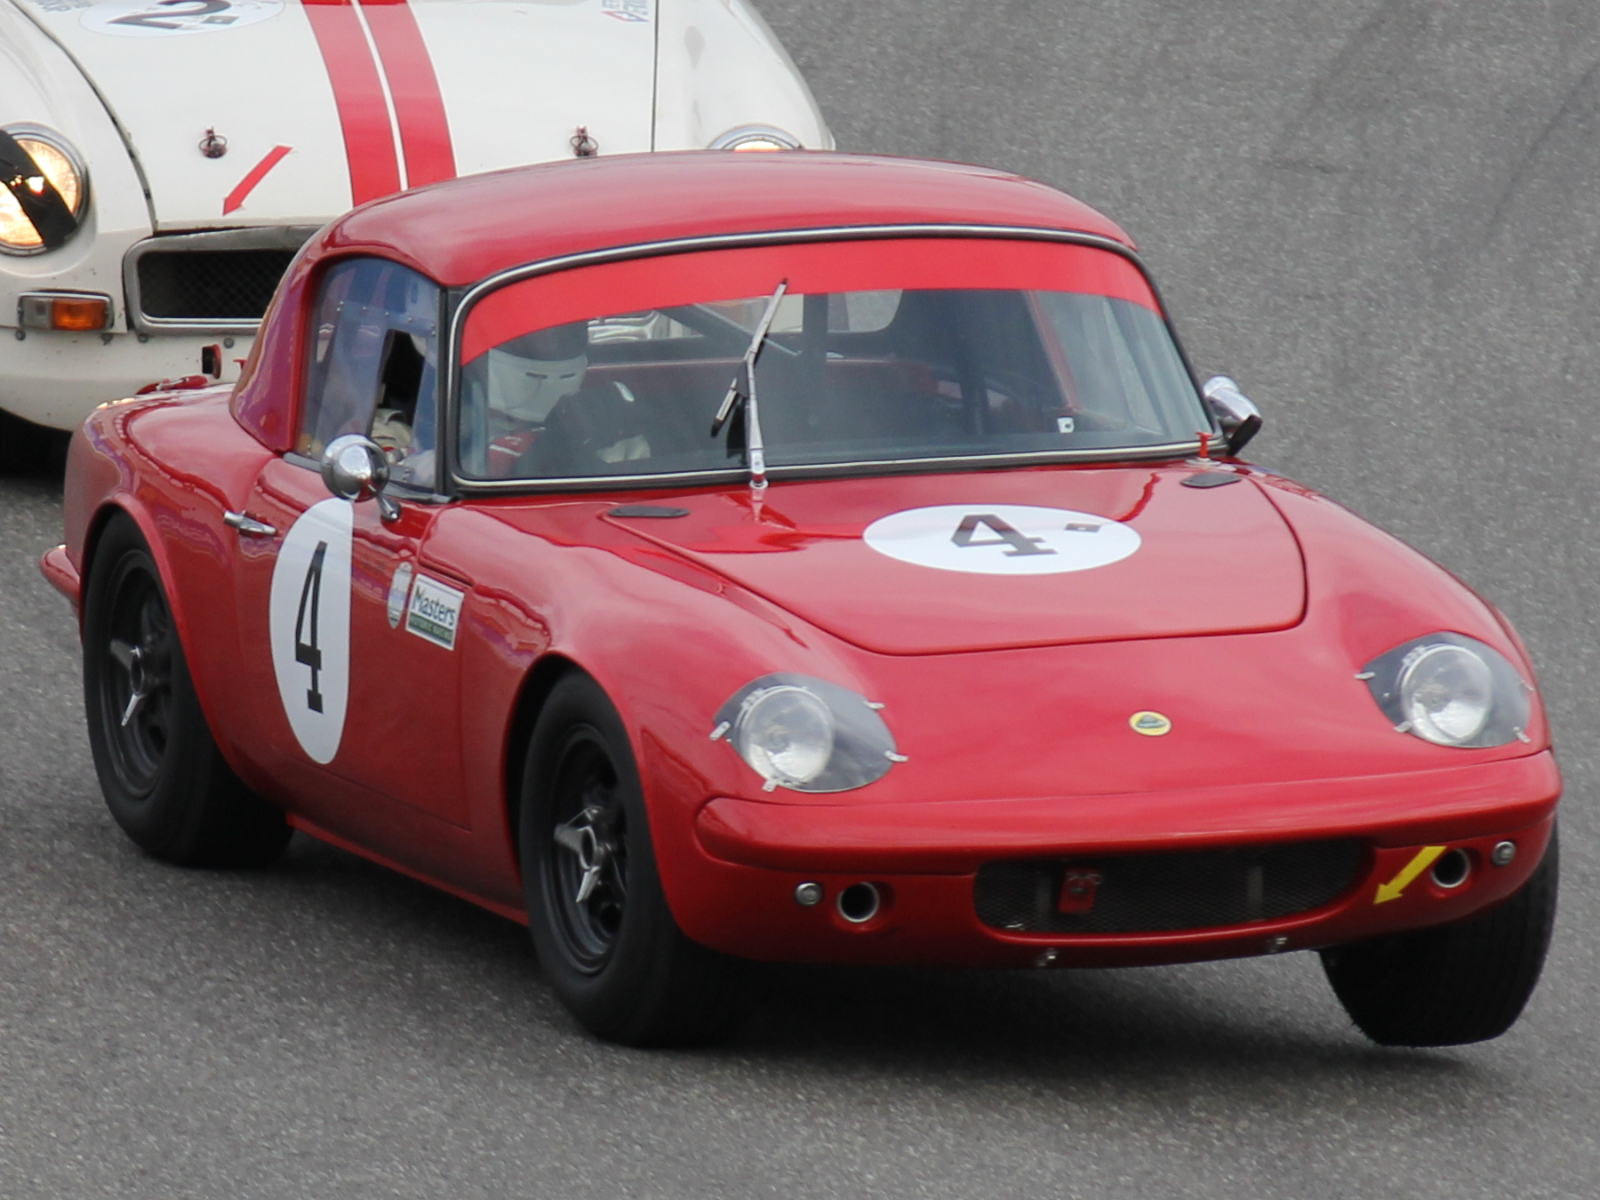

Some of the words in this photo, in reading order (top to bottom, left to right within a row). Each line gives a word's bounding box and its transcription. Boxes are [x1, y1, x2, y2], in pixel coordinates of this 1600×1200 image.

[106, 0, 231, 29] 2
[951, 514, 1058, 557] 4
[412, 585, 456, 626] Masters
[295, 540, 328, 714] 4
